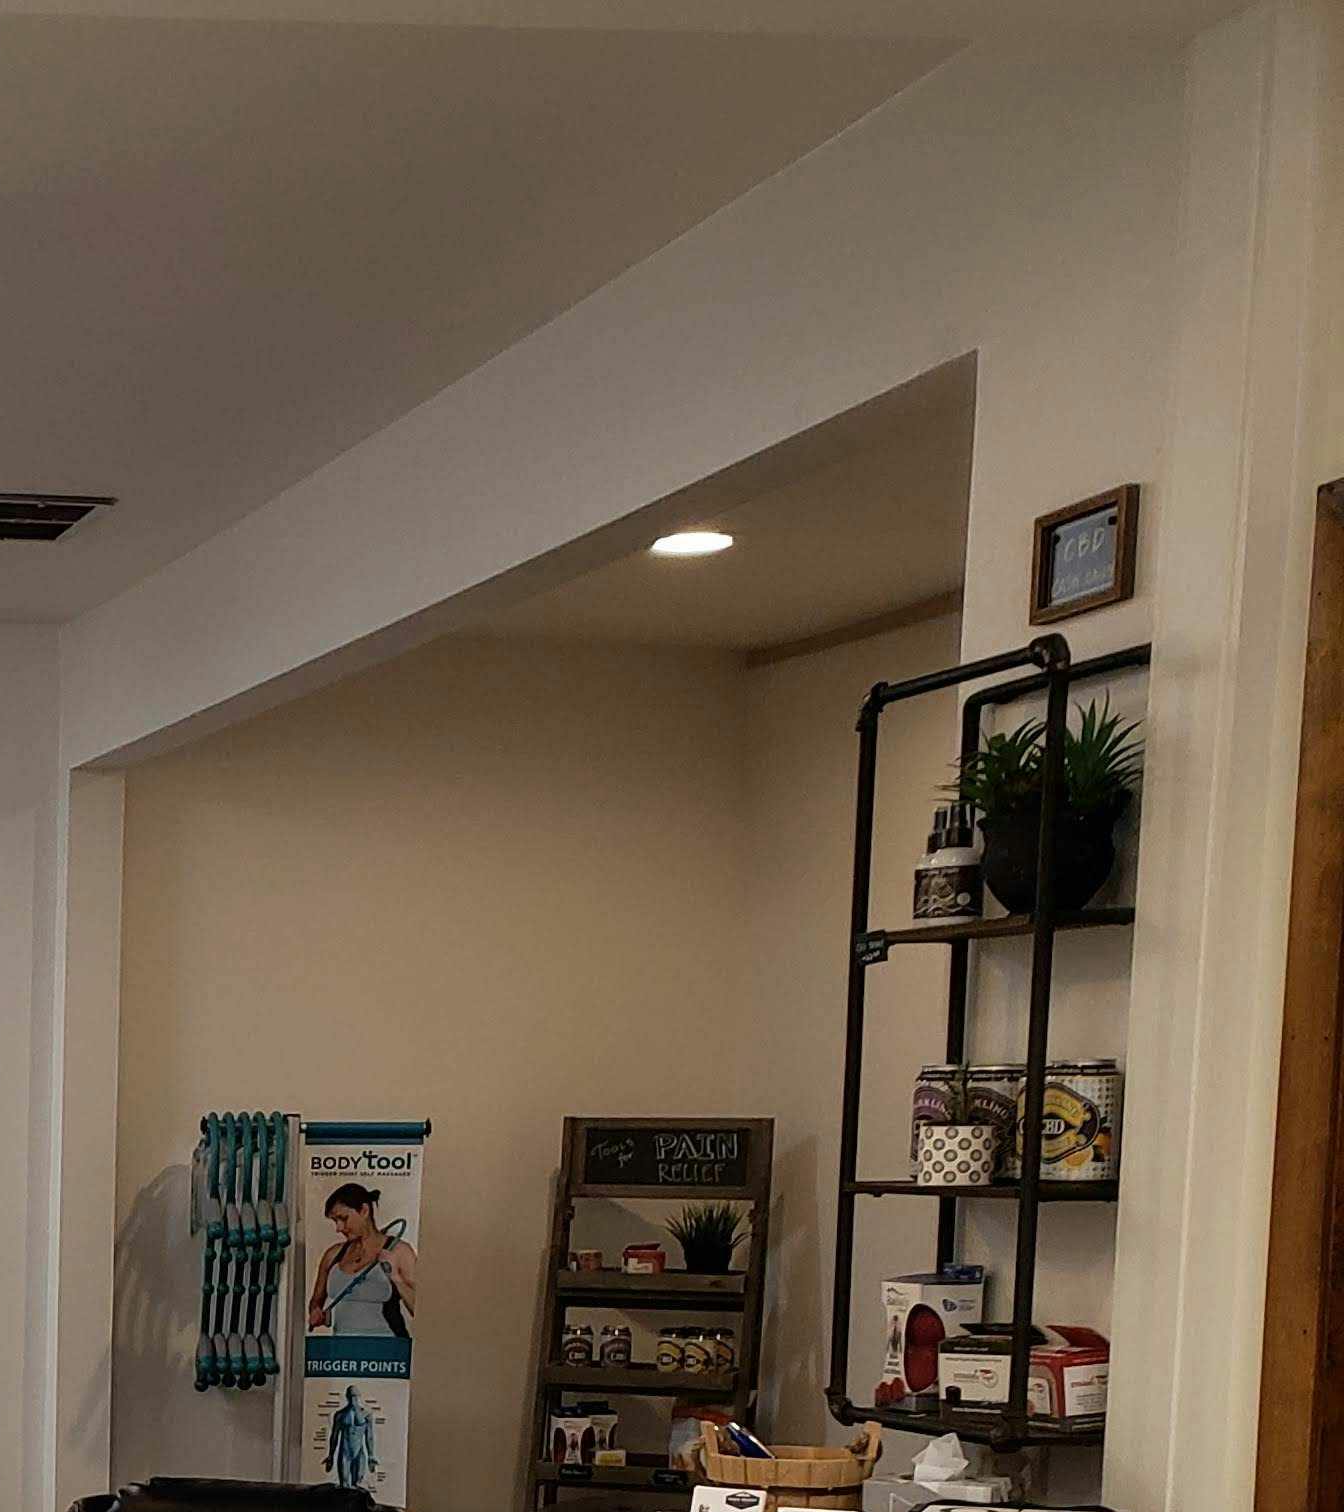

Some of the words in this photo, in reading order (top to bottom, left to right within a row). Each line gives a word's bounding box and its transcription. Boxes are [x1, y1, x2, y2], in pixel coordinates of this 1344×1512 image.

[654, 1133, 738, 1160] PAIN
[657, 1162, 727, 1184] RELIEF
[307, 1360, 357, 1372] TRIGGER
[360, 1360, 407, 1373] POINTS
